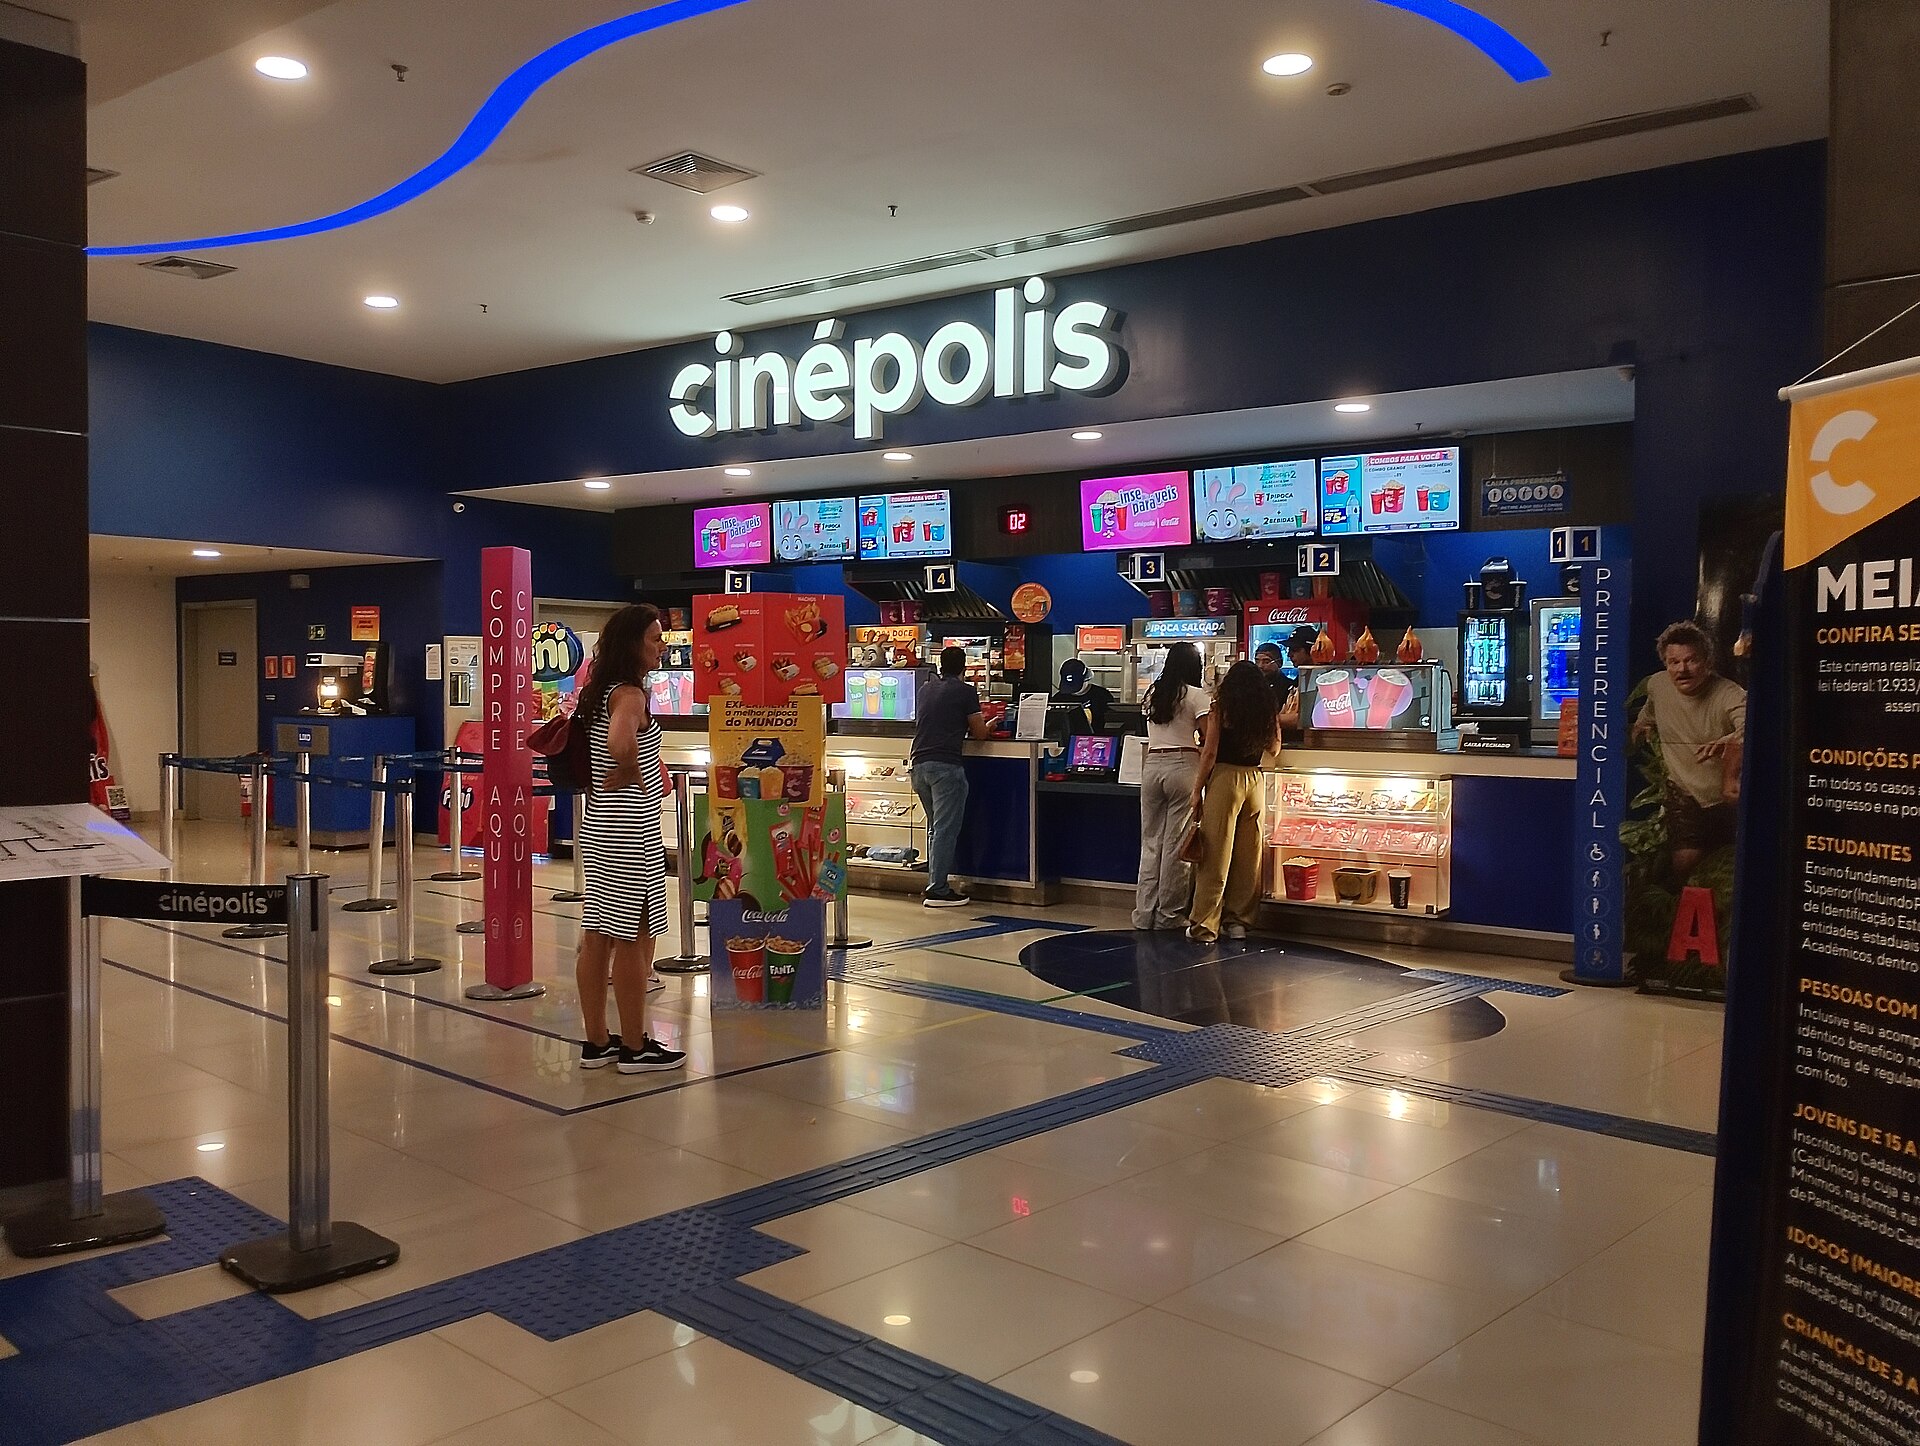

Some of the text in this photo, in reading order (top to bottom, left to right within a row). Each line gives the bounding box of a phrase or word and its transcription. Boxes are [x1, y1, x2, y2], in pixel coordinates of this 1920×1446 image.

[669, 277, 1112, 440] cinépolis
[1010, 513, 1026, 530] 02
[1556, 537, 1562, 552] 1
[1581, 536, 1589, 551] 1
[1146, 561, 1155, 574] 3
[1318, 553, 1329, 567] 2
[734, 577, 743, 589] 5
[936, 572, 946, 585] 4
[1817, 558, 1920, 613] MEI
[892, 629, 913, 637] DOCE
[1145, 621, 1226, 633] PIPOCA SALGADA
[1816, 625, 1895, 644] CONFIRA
[1819, 660, 1842, 673] Este
[1844, 660, 1887, 673] cinema
[1590, 568, 1611, 828] PREFERENCIAL
[725, 709, 798, 718] a melhor pipoca
[725, 717, 798, 727] do MUNDO!
[489, 590, 504, 889] COMPRE AQUI
[513, 590, 528, 889] COMPRE AQUI
[1809, 747, 1909, 771] CONDIÇÕES
[1809, 774, 1915, 796] Em todos os casos
[1807, 794, 1899, 815] do ingresso e na
[1806, 835, 1912, 862] ESTUDANTES
[1805, 861, 1843, 879] Ensino
[1804, 880, 1852, 899] Superior
[158, 890, 285, 917] cinépolis VIP
[1803, 899, 1820, 913] de
[1821, 902, 1896, 928] Identificação
[1667, 886, 1719, 966] A
[1802, 921, 1860, 940] entidades
[769, 965, 795, 975] FANTA
[1877, 953, 1920, 973] dentro
[1800, 978, 1918, 1020] PESSOAS COM
[1800, 1003, 1850, 1028] Inclusive
[1853, 1021, 1874, 1035] seu
[1797, 1045, 1870, 1074] na forma de
[1796, 1064, 1822, 1079] com
[1793, 1103, 1918, 1157] JOVENS DE 15 A
[1842, 1148, 1858, 1162] no
[1861, 1152, 1916, 1183] Cadastro
[1787, 1226, 1849, 1264] IDOSOS
[1783, 1313, 1919, 1395] CRIANÇAS DE 3 A
